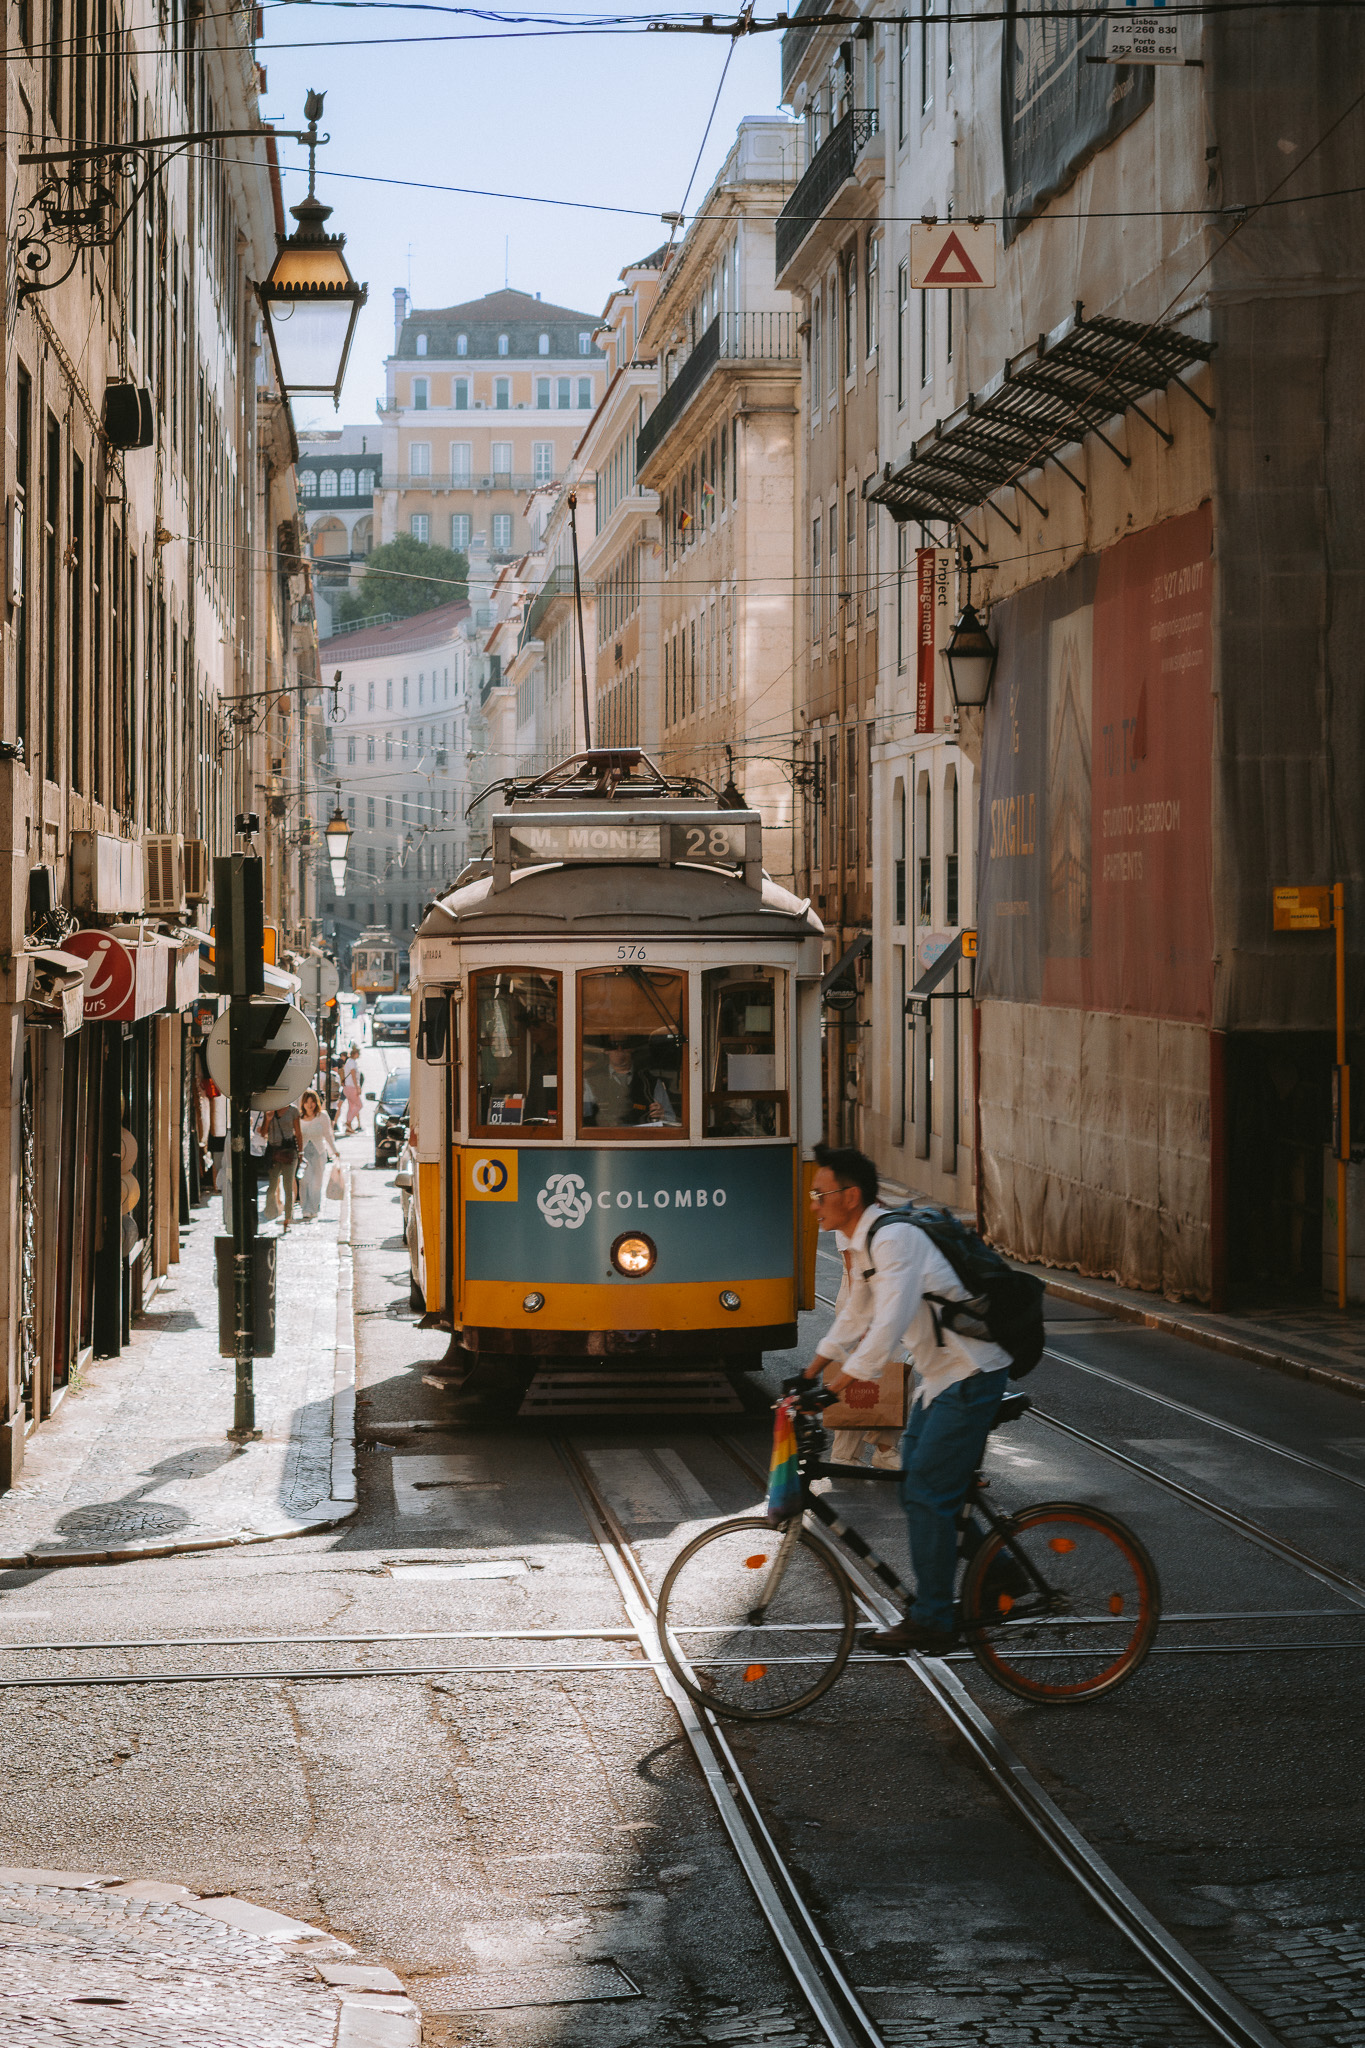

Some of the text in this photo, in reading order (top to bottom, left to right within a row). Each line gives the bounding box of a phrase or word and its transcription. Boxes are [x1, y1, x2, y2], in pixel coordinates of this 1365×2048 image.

[1135, 26, 1155, 34] 260
[1158, 26, 1177, 34] 830
[1112, 45, 1177, 54] 252 685 651
[937, 558, 950, 606] Project
[919, 558, 934, 646] Management
[919, 682, 927, 698] 213
[919, 699, 927, 715] 583
[530, 828, 655, 849] M. MONIZ
[685, 828, 731, 857] 28
[617, 945, 646, 960] 576
[491, 1113, 503, 1123] 01
[596, 1188, 728, 1209] COLOMBO
